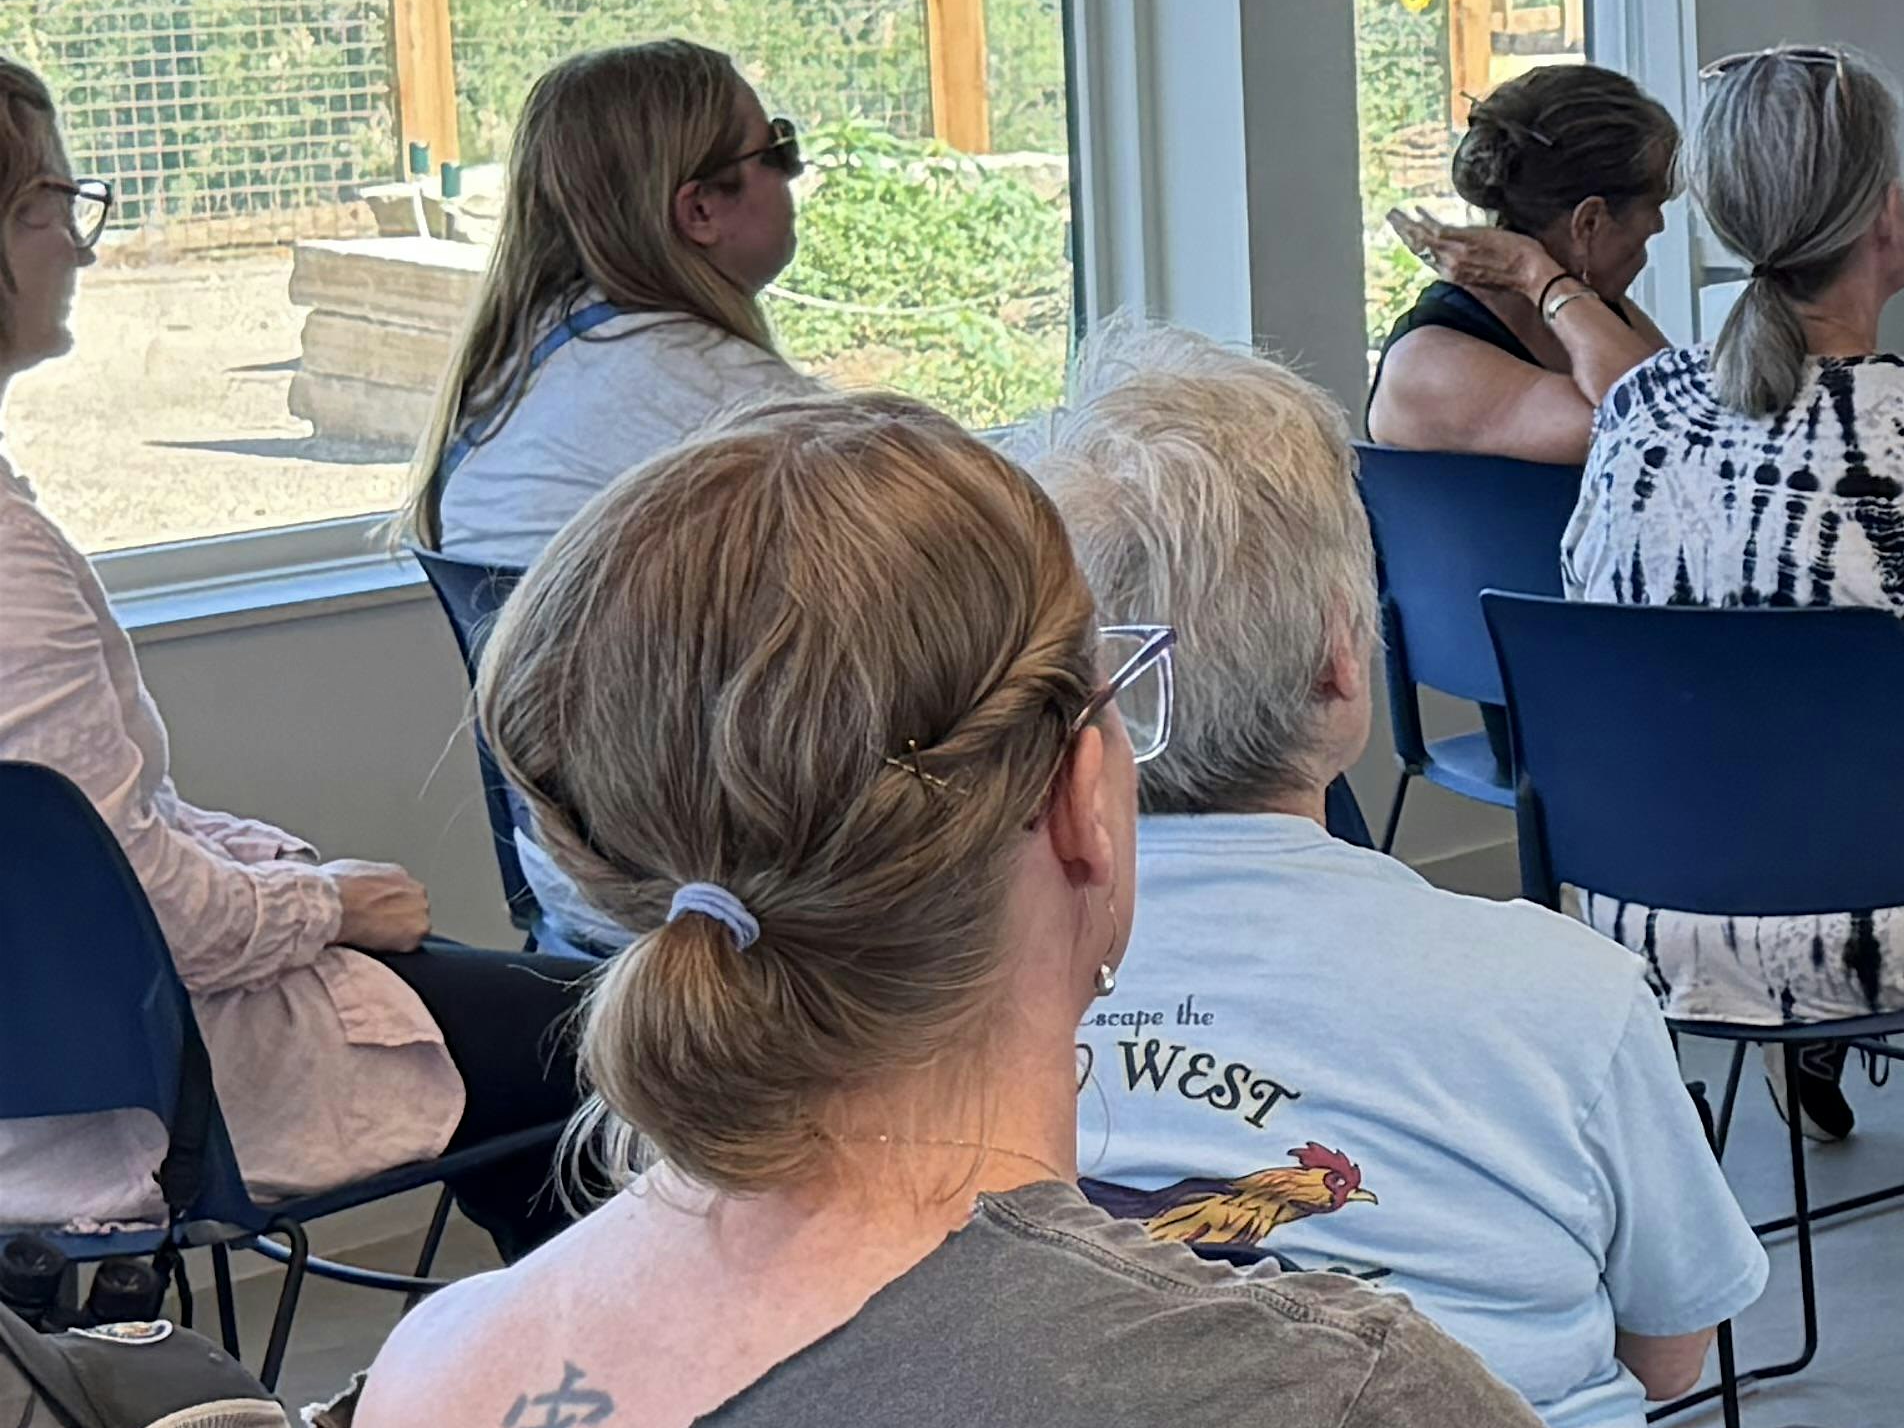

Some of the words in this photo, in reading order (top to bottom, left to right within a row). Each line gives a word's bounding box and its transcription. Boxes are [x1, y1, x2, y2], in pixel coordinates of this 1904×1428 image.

[1078, 1010, 1163, 1036] scape
[1176, 994, 1214, 1026] the
[1117, 1038, 1301, 1129] WEST
